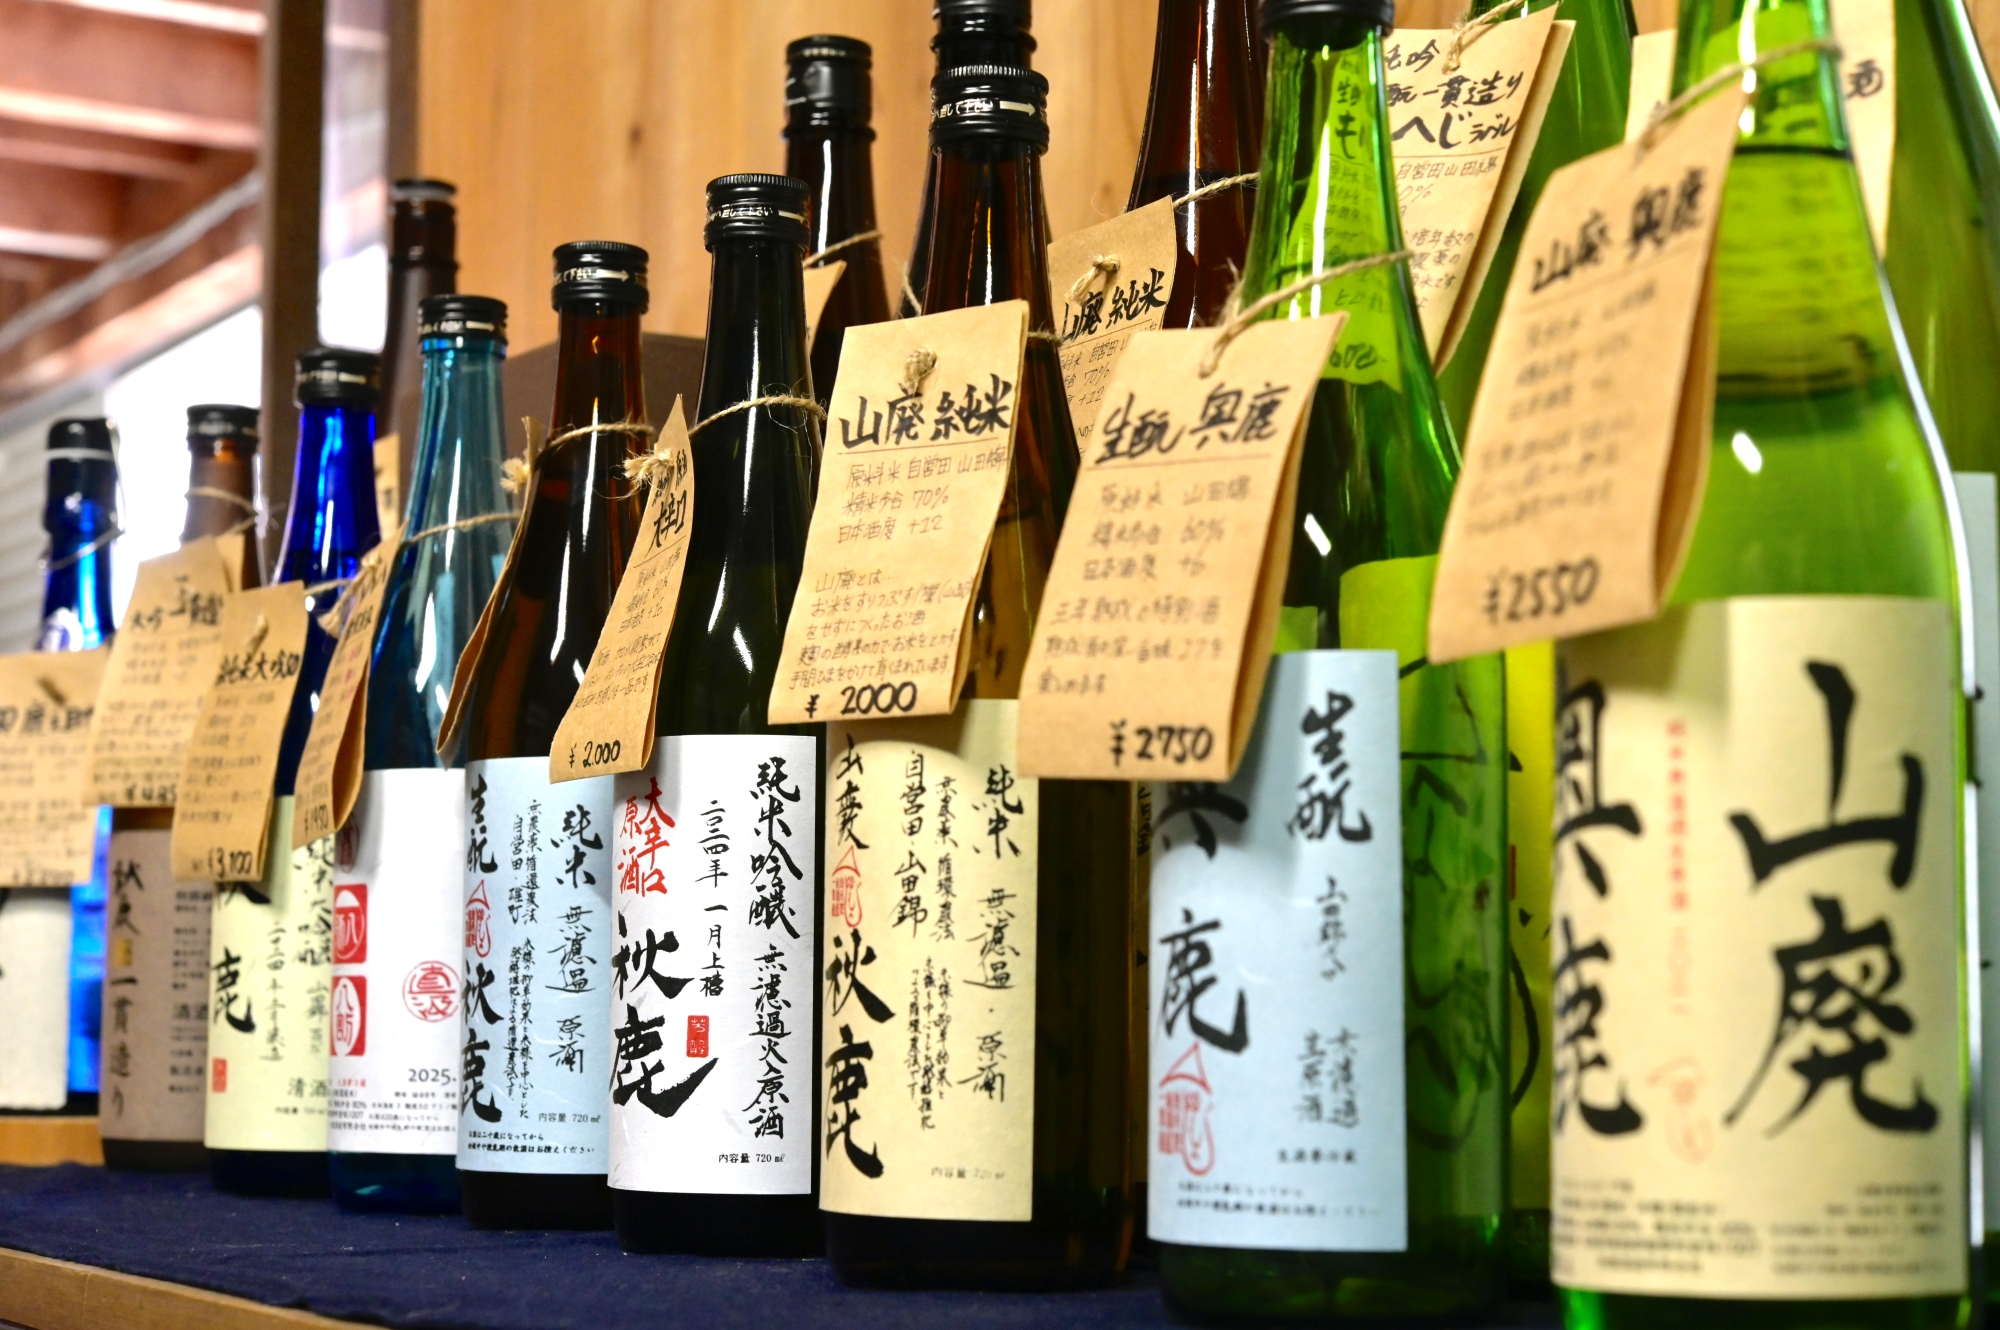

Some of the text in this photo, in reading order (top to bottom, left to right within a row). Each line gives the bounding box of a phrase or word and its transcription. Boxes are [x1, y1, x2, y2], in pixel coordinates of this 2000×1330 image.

[847, 460, 901, 489] 原料米
[907, 454, 952, 479] 自営田
[913, 485, 949, 509] 70%
[838, 515, 942, 544] 日本酒度 +12
[841, 681, 918, 716] 2000
[617, 795, 642, 895] 原酒
[1727, 657, 1941, 1140] 山廃
[612, 909, 719, 1118] 秋鹿
[826, 928, 896, 1178] 秋鹿
[538, 1112, 568, 1123] 内容量
[572, 1113, 589, 1123] 720
[718, 1153, 750, 1163] 内容量
[755, 1153, 772, 1163] 720
